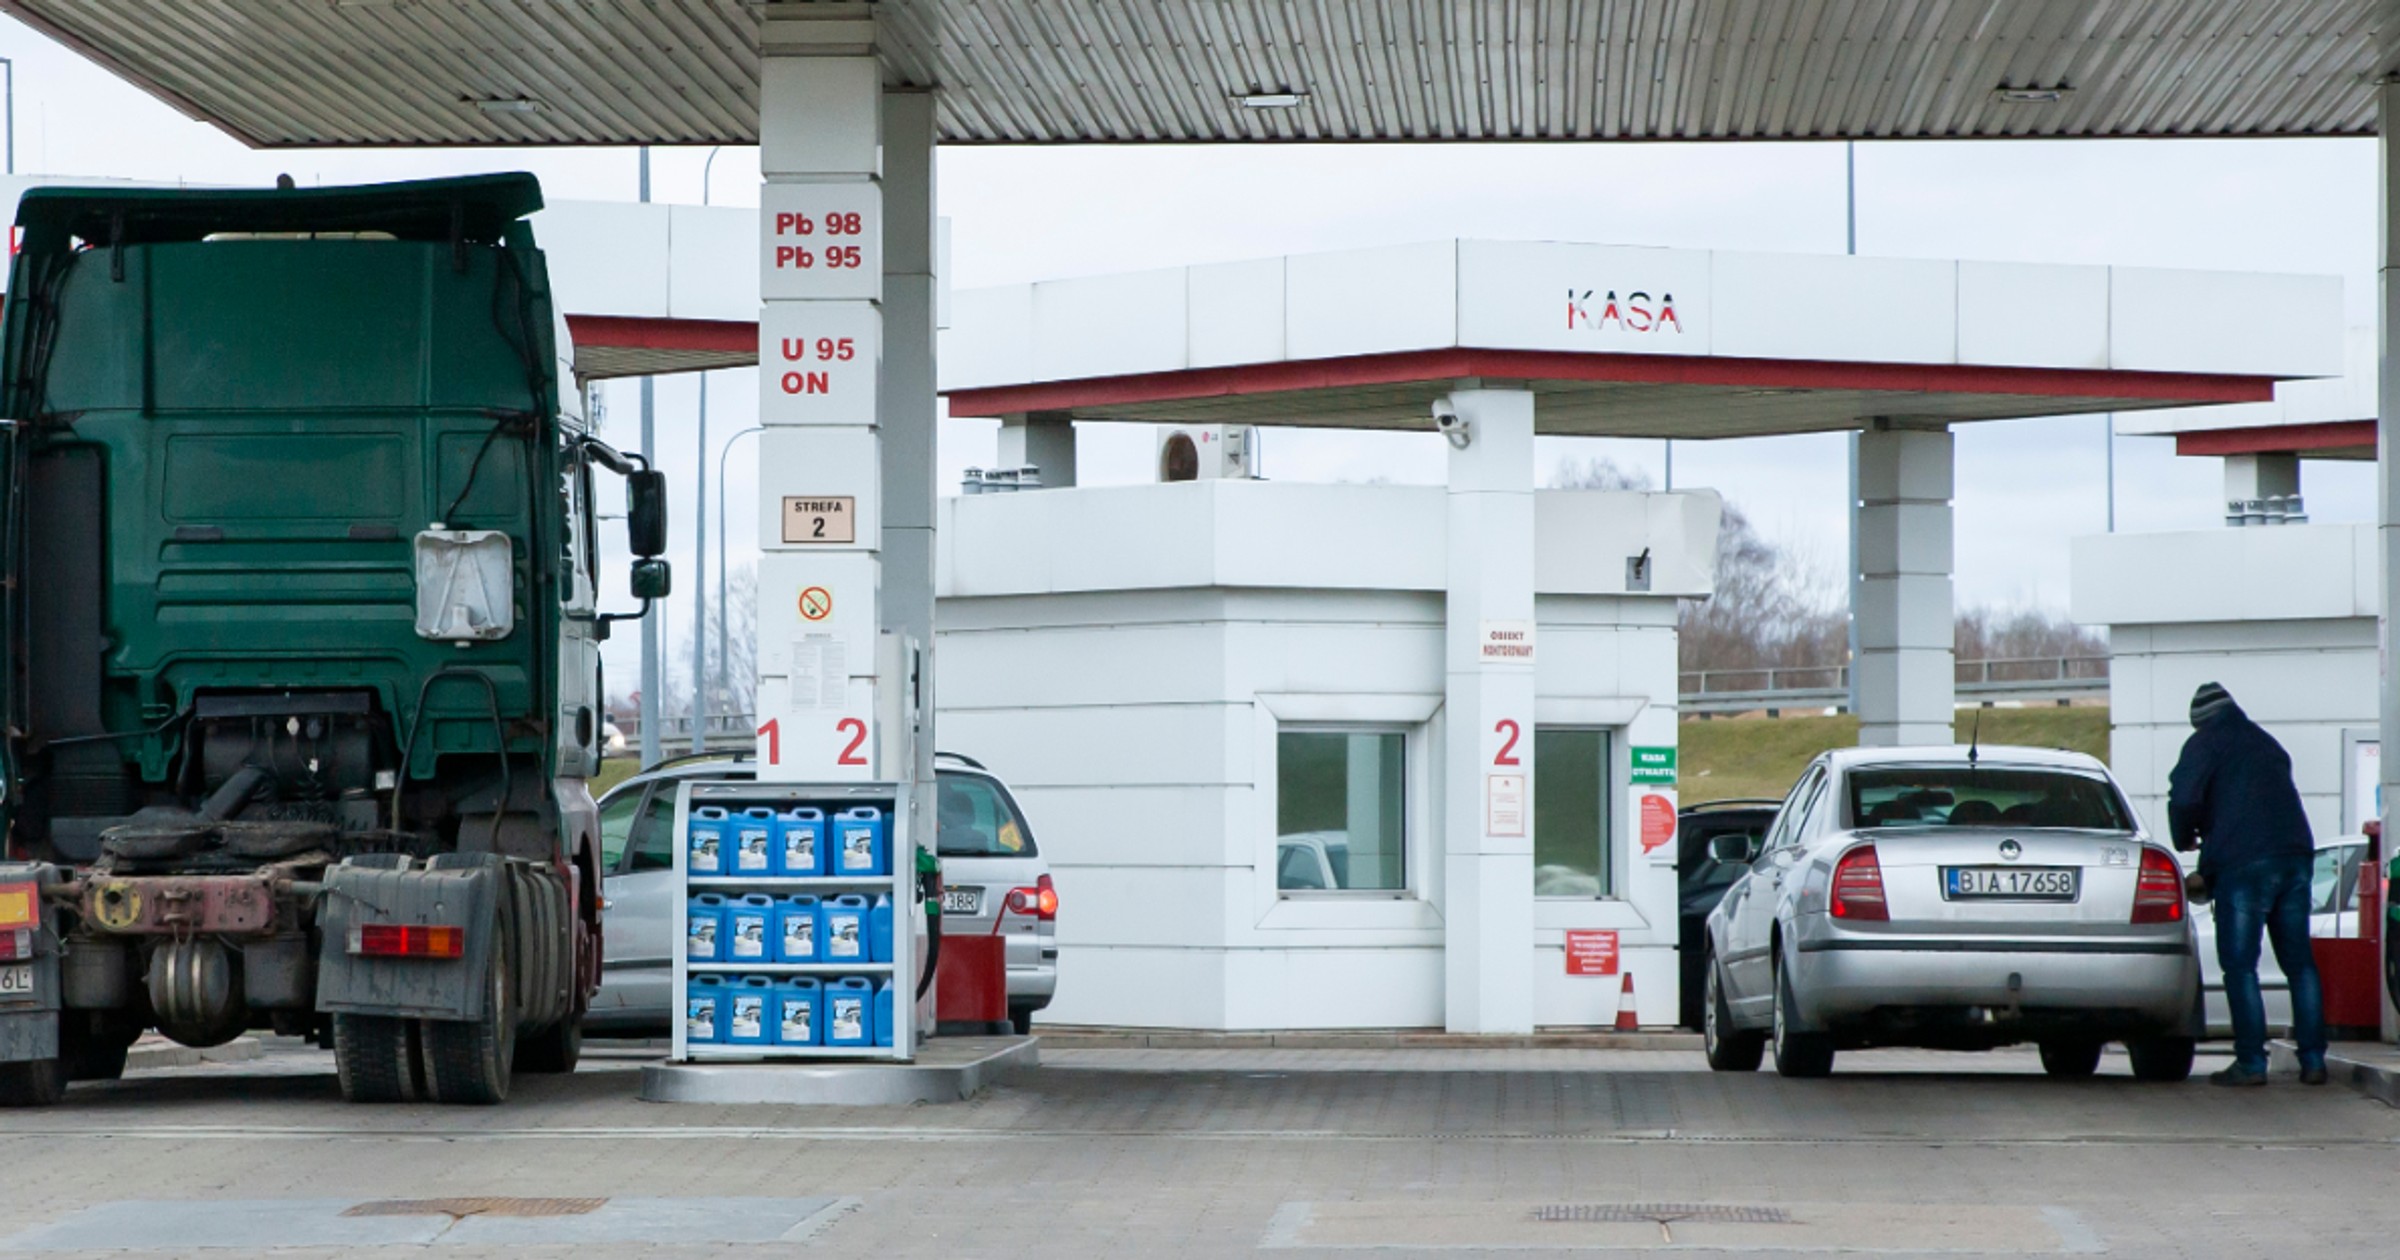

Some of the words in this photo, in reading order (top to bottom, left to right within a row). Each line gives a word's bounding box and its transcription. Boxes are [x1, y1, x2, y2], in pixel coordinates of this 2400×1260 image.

[776, 212, 814, 235] Pb
[825, 212, 862, 235] 98
[776, 246, 814, 268] Pb
[825, 246, 862, 268] 95
[1567, 288, 1684, 334] KASA
[781, 338, 805, 361] U
[816, 338, 855, 361] 95
[781, 372, 829, 394] ON
[795, 501, 843, 512] STREFA
[812, 516, 826, 538] 2
[757, 717, 780, 765] 1
[836, 717, 868, 765] 2
[1493, 718, 1520, 766] 2
[1960, 871, 2001, 892] BIA
[2009, 872, 2071, 893] 17658
[2, 966, 29, 990] 6L
